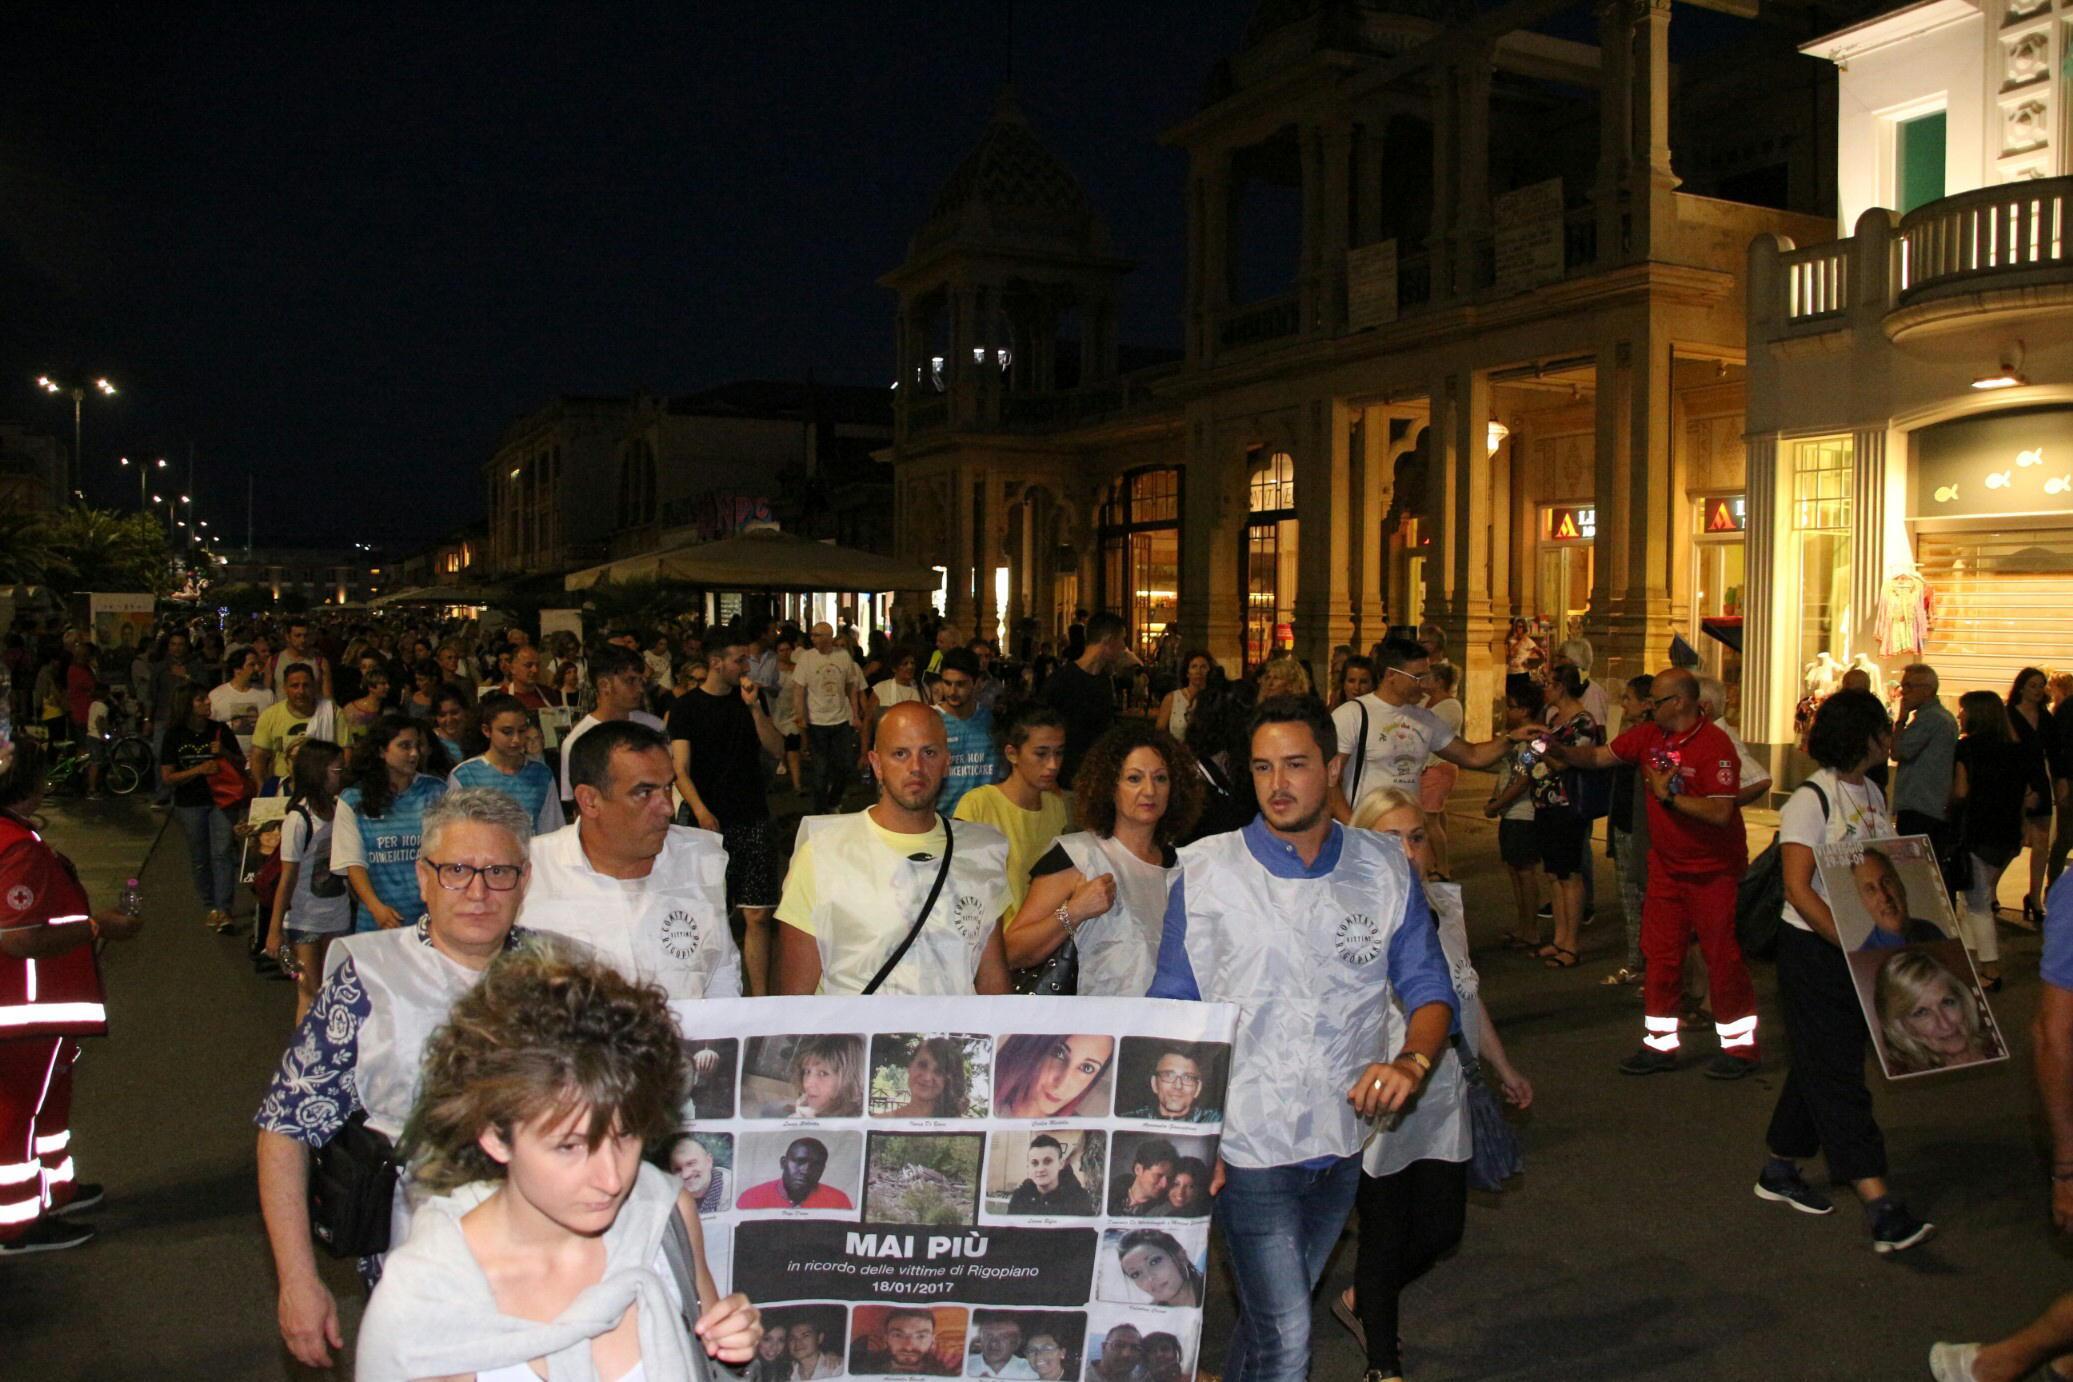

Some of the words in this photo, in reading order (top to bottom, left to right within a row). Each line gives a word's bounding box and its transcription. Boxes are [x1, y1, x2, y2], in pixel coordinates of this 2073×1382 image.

[376, 835, 398, 848] PER
[368, 849, 422, 864] DIMENTICA
[661, 910, 698, 933] COMITATO
[1336, 914, 1378, 937] COMITATO
[845, 1232, 914, 1258] MAI
[927, 1230, 989, 1259] PIÙ
[787, 1260, 800, 1272] in
[805, 1260, 856, 1274] ricordo
[860, 1264, 894, 1276] delle
[899, 1264, 945, 1277] vittime
[950, 1263, 964, 1276] di
[967, 1264, 1039, 1279] Rigopiano
[872, 1281, 954, 1294] 18/01/2017
